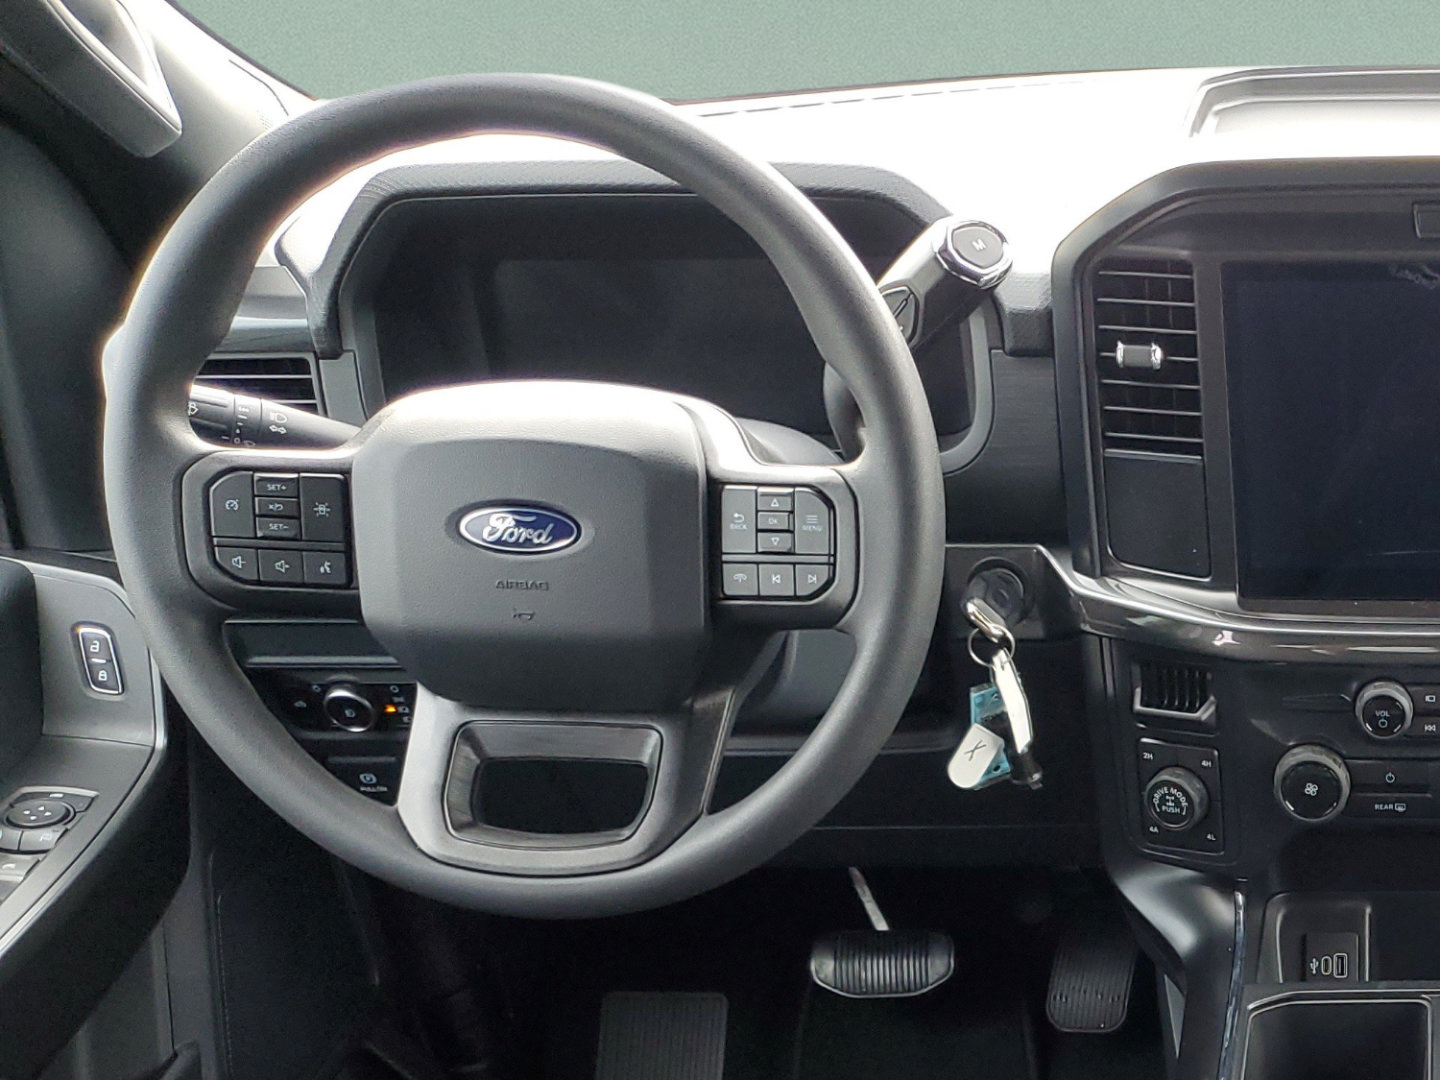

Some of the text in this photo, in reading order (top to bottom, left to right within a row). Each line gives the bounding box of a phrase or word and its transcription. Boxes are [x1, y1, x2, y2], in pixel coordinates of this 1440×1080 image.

[971, 238, 987, 251] M
[266, 483, 287, 491] SET+
[482, 512, 555, 544] Ford
[495, 580, 549, 591] AIRBAG
[1375, 710, 1391, 718] VOL
[1143, 752, 1154, 760] 2H
[1201, 760, 1212, 768] 4H
[1153, 786, 1189, 807] DRIVE MODE
[1374, 803, 1394, 811] REAR
[1206, 833, 1217, 841] 4L
